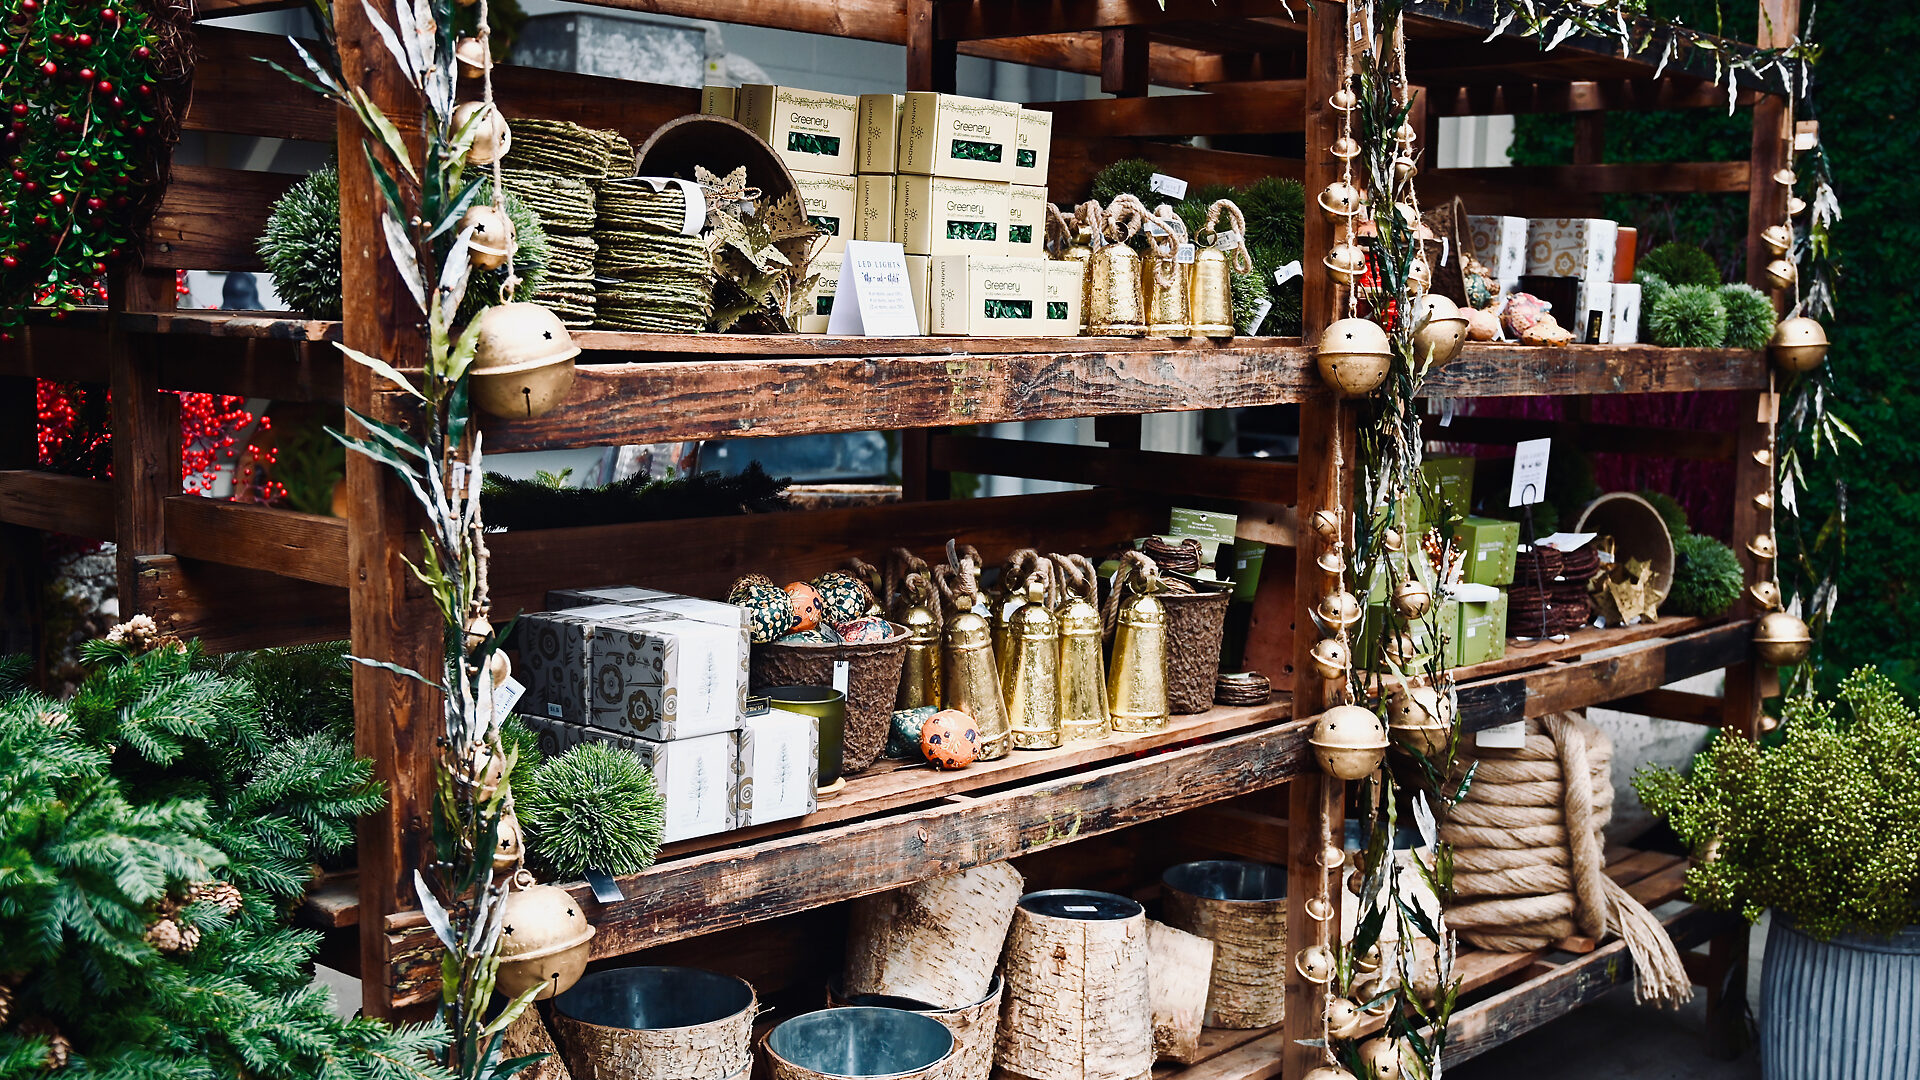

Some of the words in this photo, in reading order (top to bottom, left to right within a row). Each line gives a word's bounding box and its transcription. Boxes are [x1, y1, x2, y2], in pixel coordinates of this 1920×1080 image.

[790, 112, 829, 129] Greenery
[953, 119, 991, 136] Greenery
[910, 125, 915, 136] OF
[947, 200, 984, 215] Greenery
[857, 260, 872, 268] LED
[874, 261, 901, 269] LIGHTS
[984, 279, 1021, 293] Greenery
